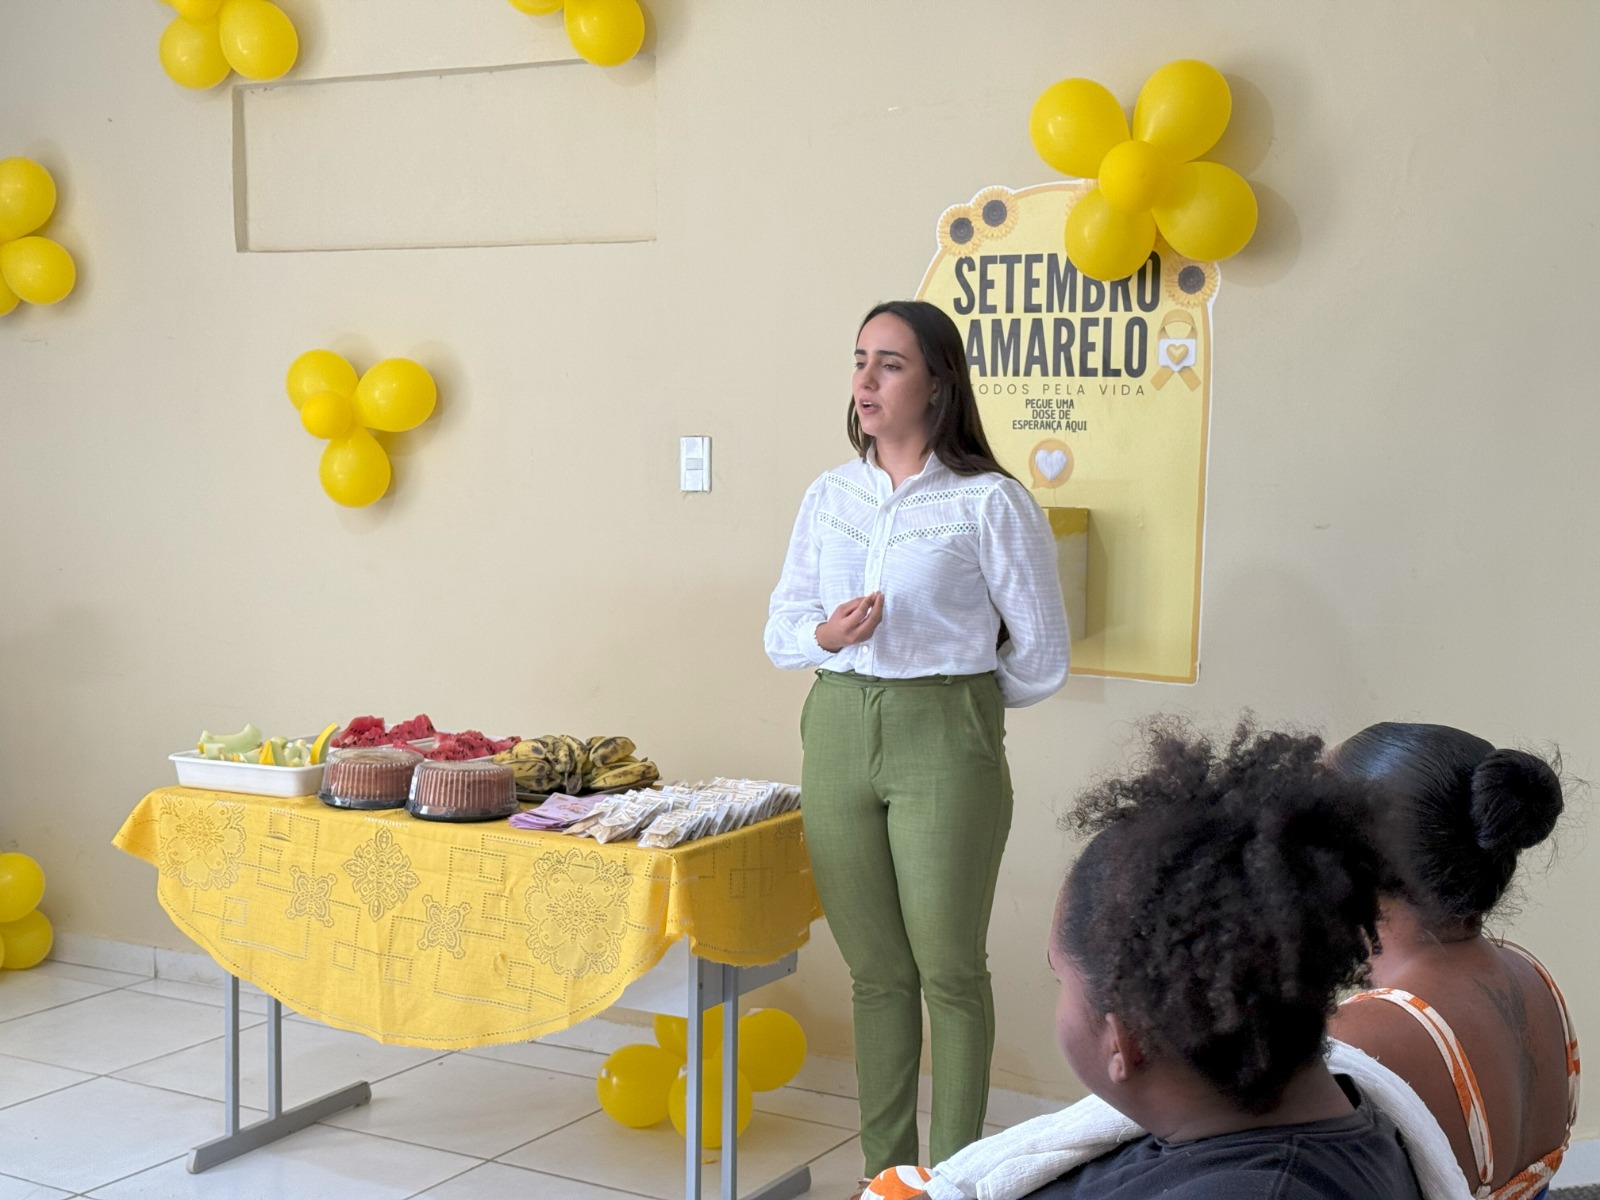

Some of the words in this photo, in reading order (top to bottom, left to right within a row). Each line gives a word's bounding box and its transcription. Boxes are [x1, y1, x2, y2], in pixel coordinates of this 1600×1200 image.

[953, 250, 1161, 315] SETEMBRO
[966, 316, 1148, 378] AMARELO
[971, 383, 1030, 395] ODOS
[1042, 383, 1086, 396] PELA
[1099, 384, 1145, 396] VIDA
[1025, 398, 1054, 409] PEGUE
[1056, 399, 1075, 409] UMA
[1032, 409, 1056, 420] DOSE
[1059, 409, 1071, 420] DE
[1012, 420, 1063, 433] ESPERANÇA
[1065, 420, 1088, 433] AQUI
